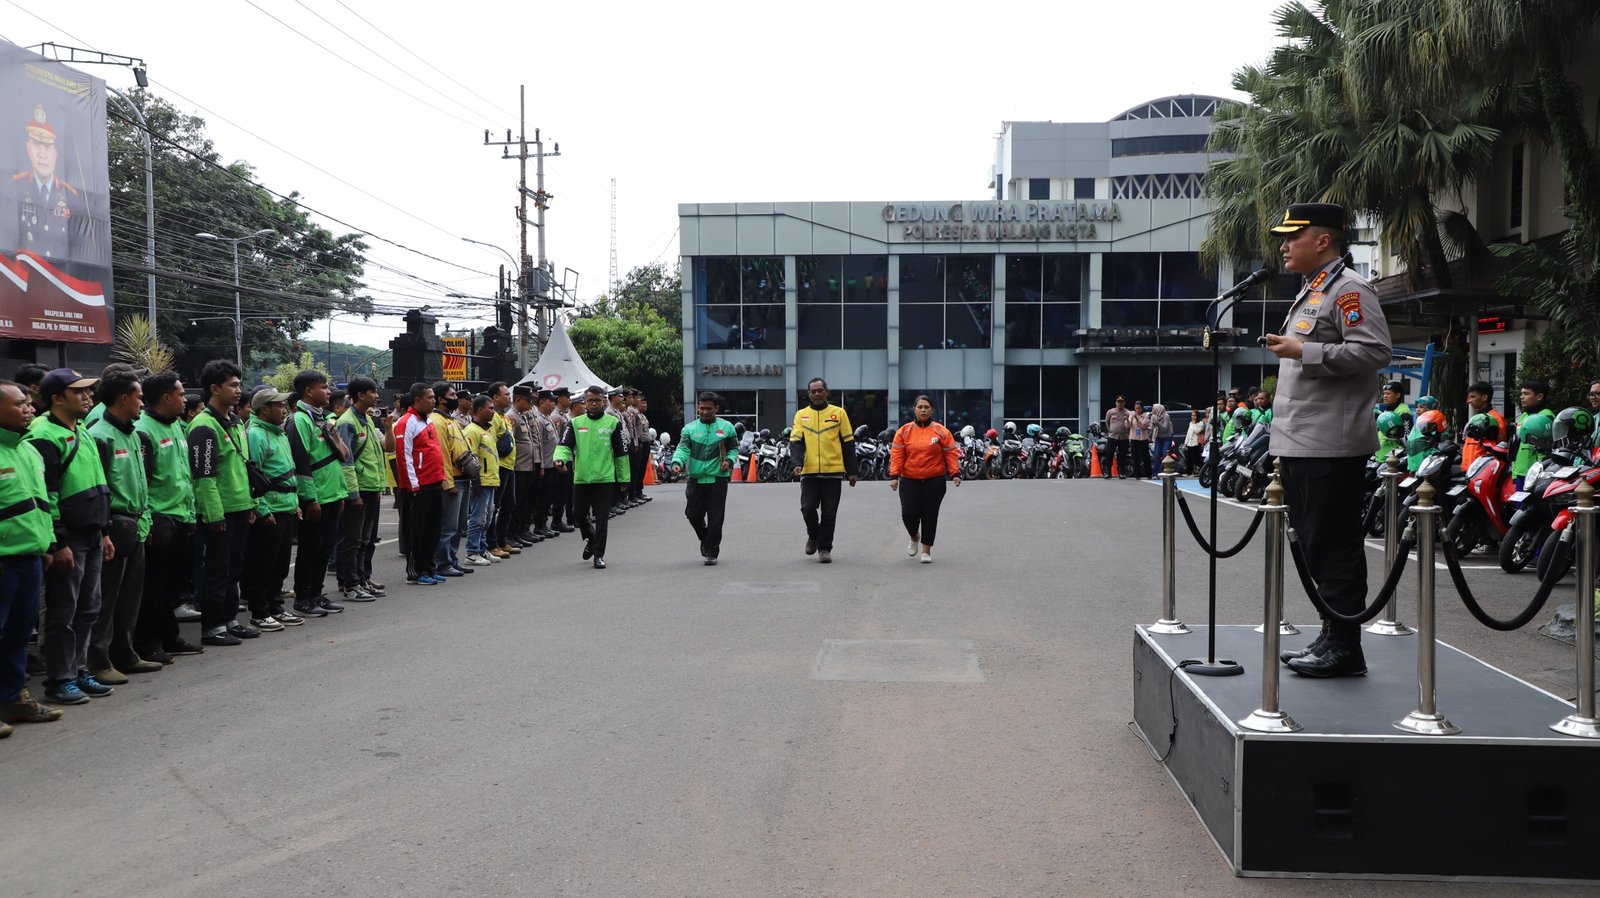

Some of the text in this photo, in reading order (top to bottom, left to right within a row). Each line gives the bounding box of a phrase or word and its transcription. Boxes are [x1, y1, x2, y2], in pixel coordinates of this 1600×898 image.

[882, 203, 1121, 222] GEDUNG WIRA PRATAMA
[903, 224, 1097, 240] POLRESTA MALANG KOTA
[1302, 308, 1317, 316] POLRI
[203, 438, 214, 475] tokopedia
